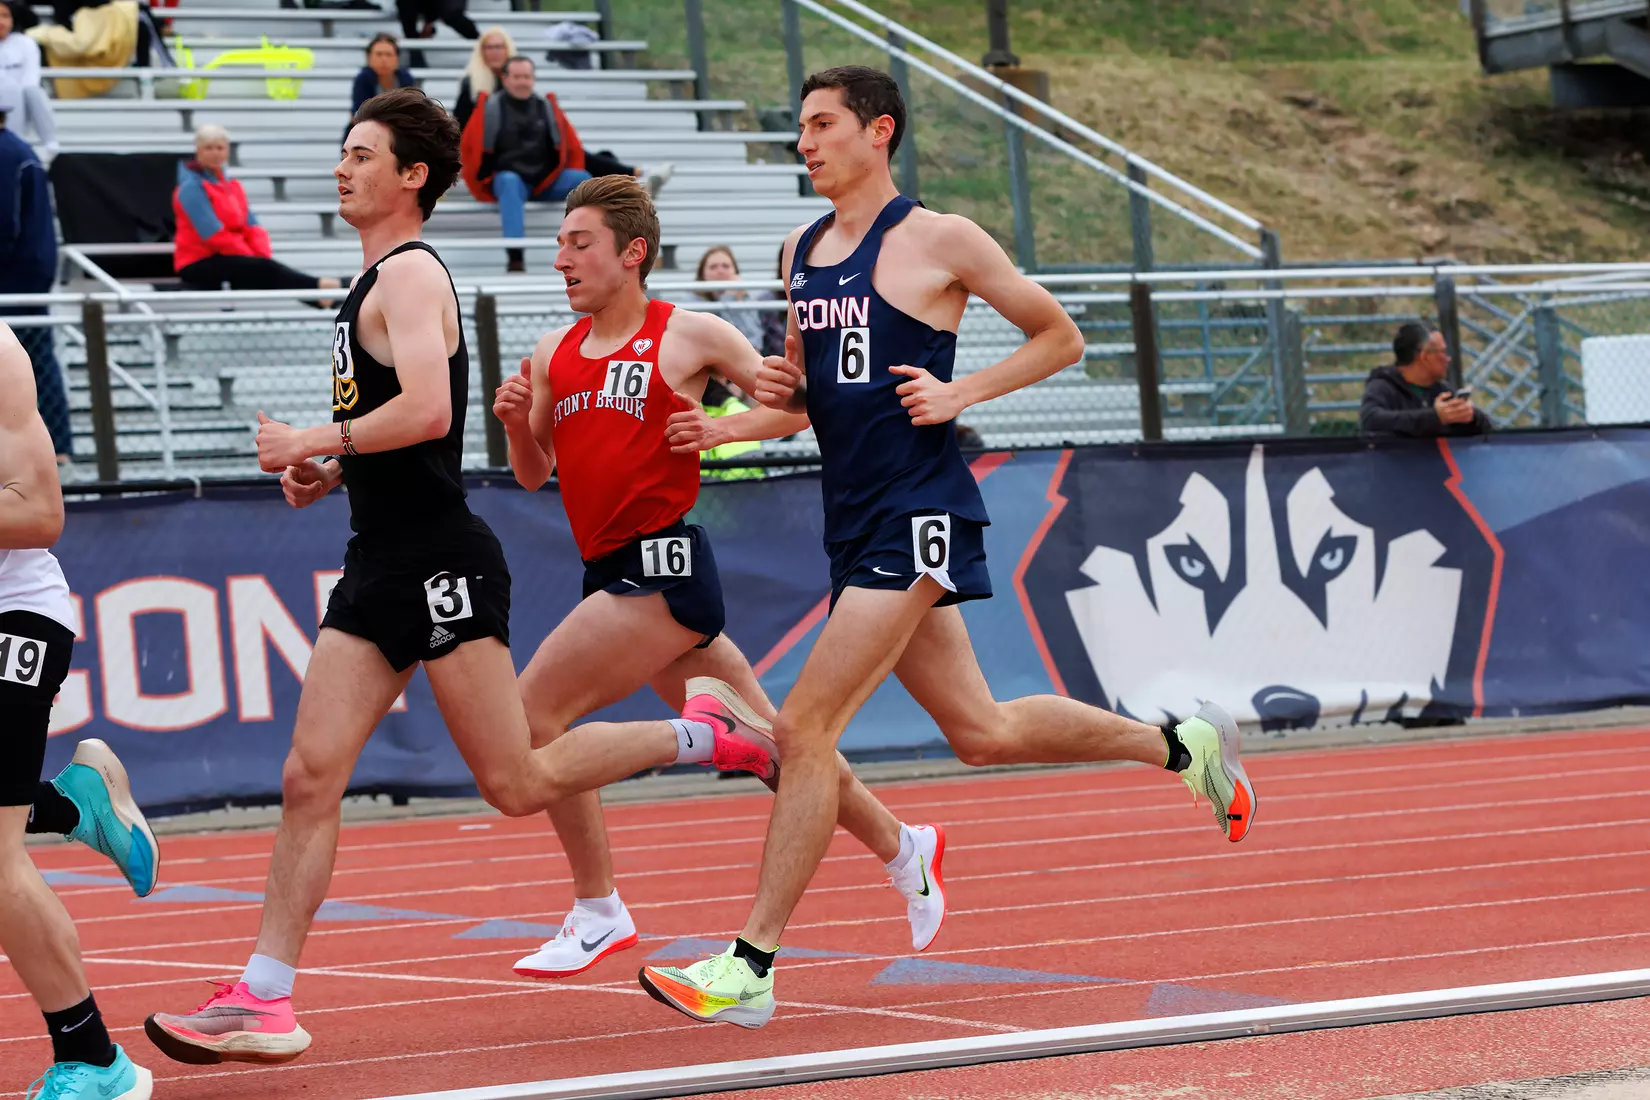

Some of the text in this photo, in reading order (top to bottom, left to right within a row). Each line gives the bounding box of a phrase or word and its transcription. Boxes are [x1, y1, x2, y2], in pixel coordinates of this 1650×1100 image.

[792, 296, 870, 332] CONN
[336, 326, 348, 375] 3
[841, 331, 865, 380] 6
[610, 362, 645, 398] 16
[595, 389, 646, 422] BROOK
[645, 539, 686, 575] 16
[918, 519, 947, 569] 6
[430, 572, 464, 619] 3
[0, 636, 41, 683] 19
